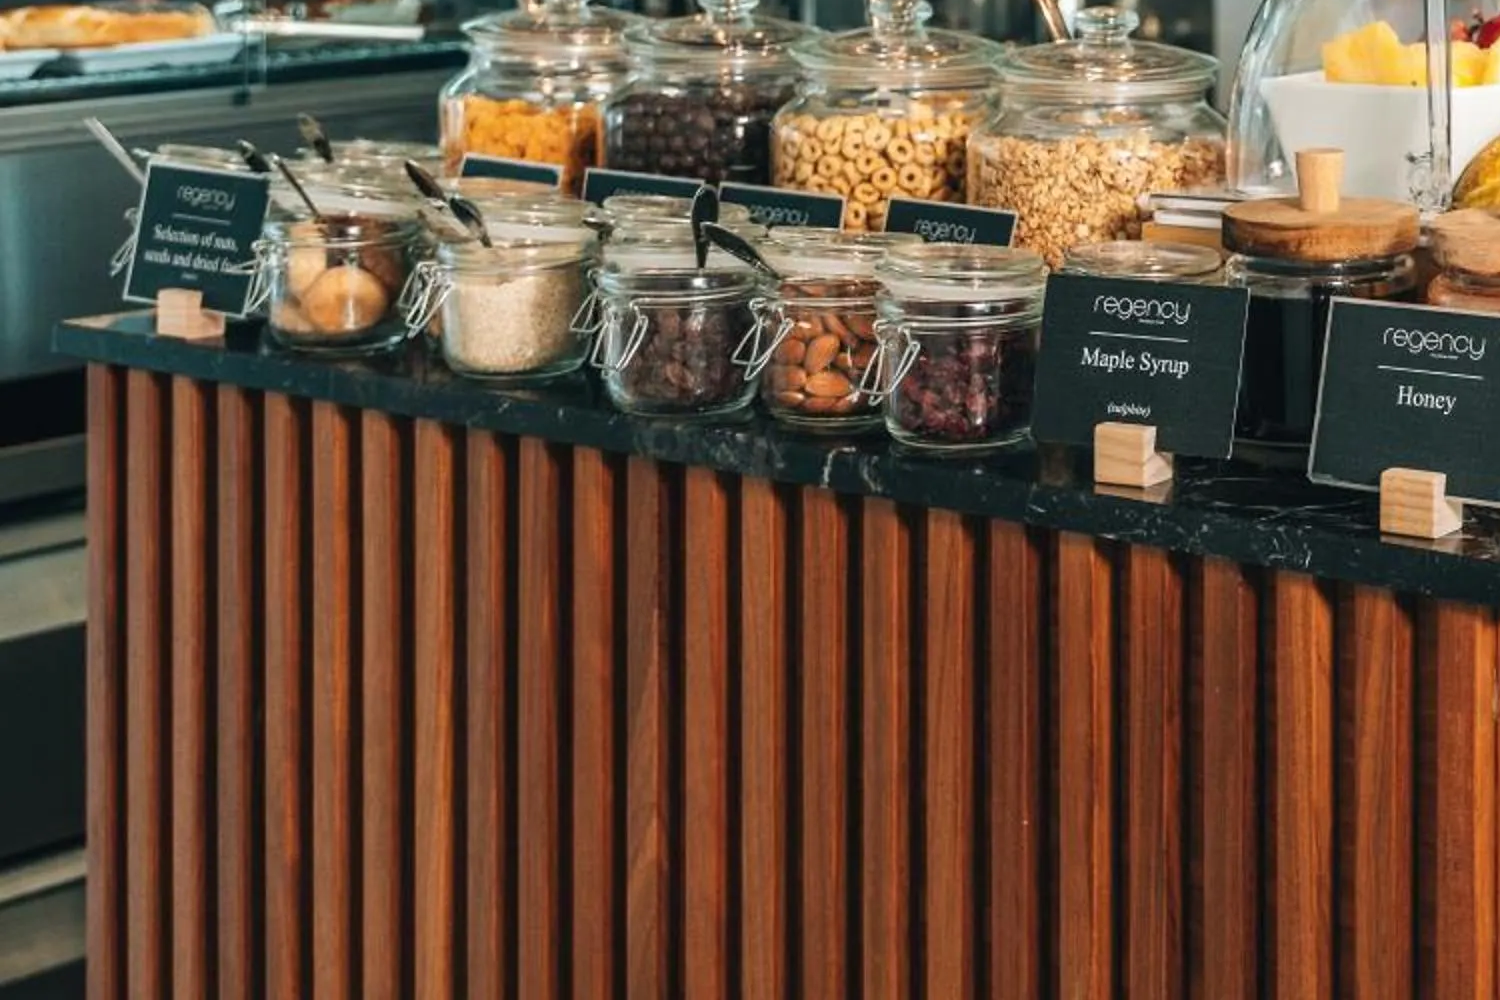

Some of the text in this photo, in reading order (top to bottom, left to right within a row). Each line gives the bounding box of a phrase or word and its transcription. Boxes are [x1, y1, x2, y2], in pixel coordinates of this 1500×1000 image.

[176, 185, 236, 212] regency
[913, 219, 977, 244] regency
[1093, 295, 1192, 325] regency
[1383, 327, 1487, 361] regency
[1080, 346, 1190, 379] Maple Syrup
[1396, 384, 1457, 415] Honey
